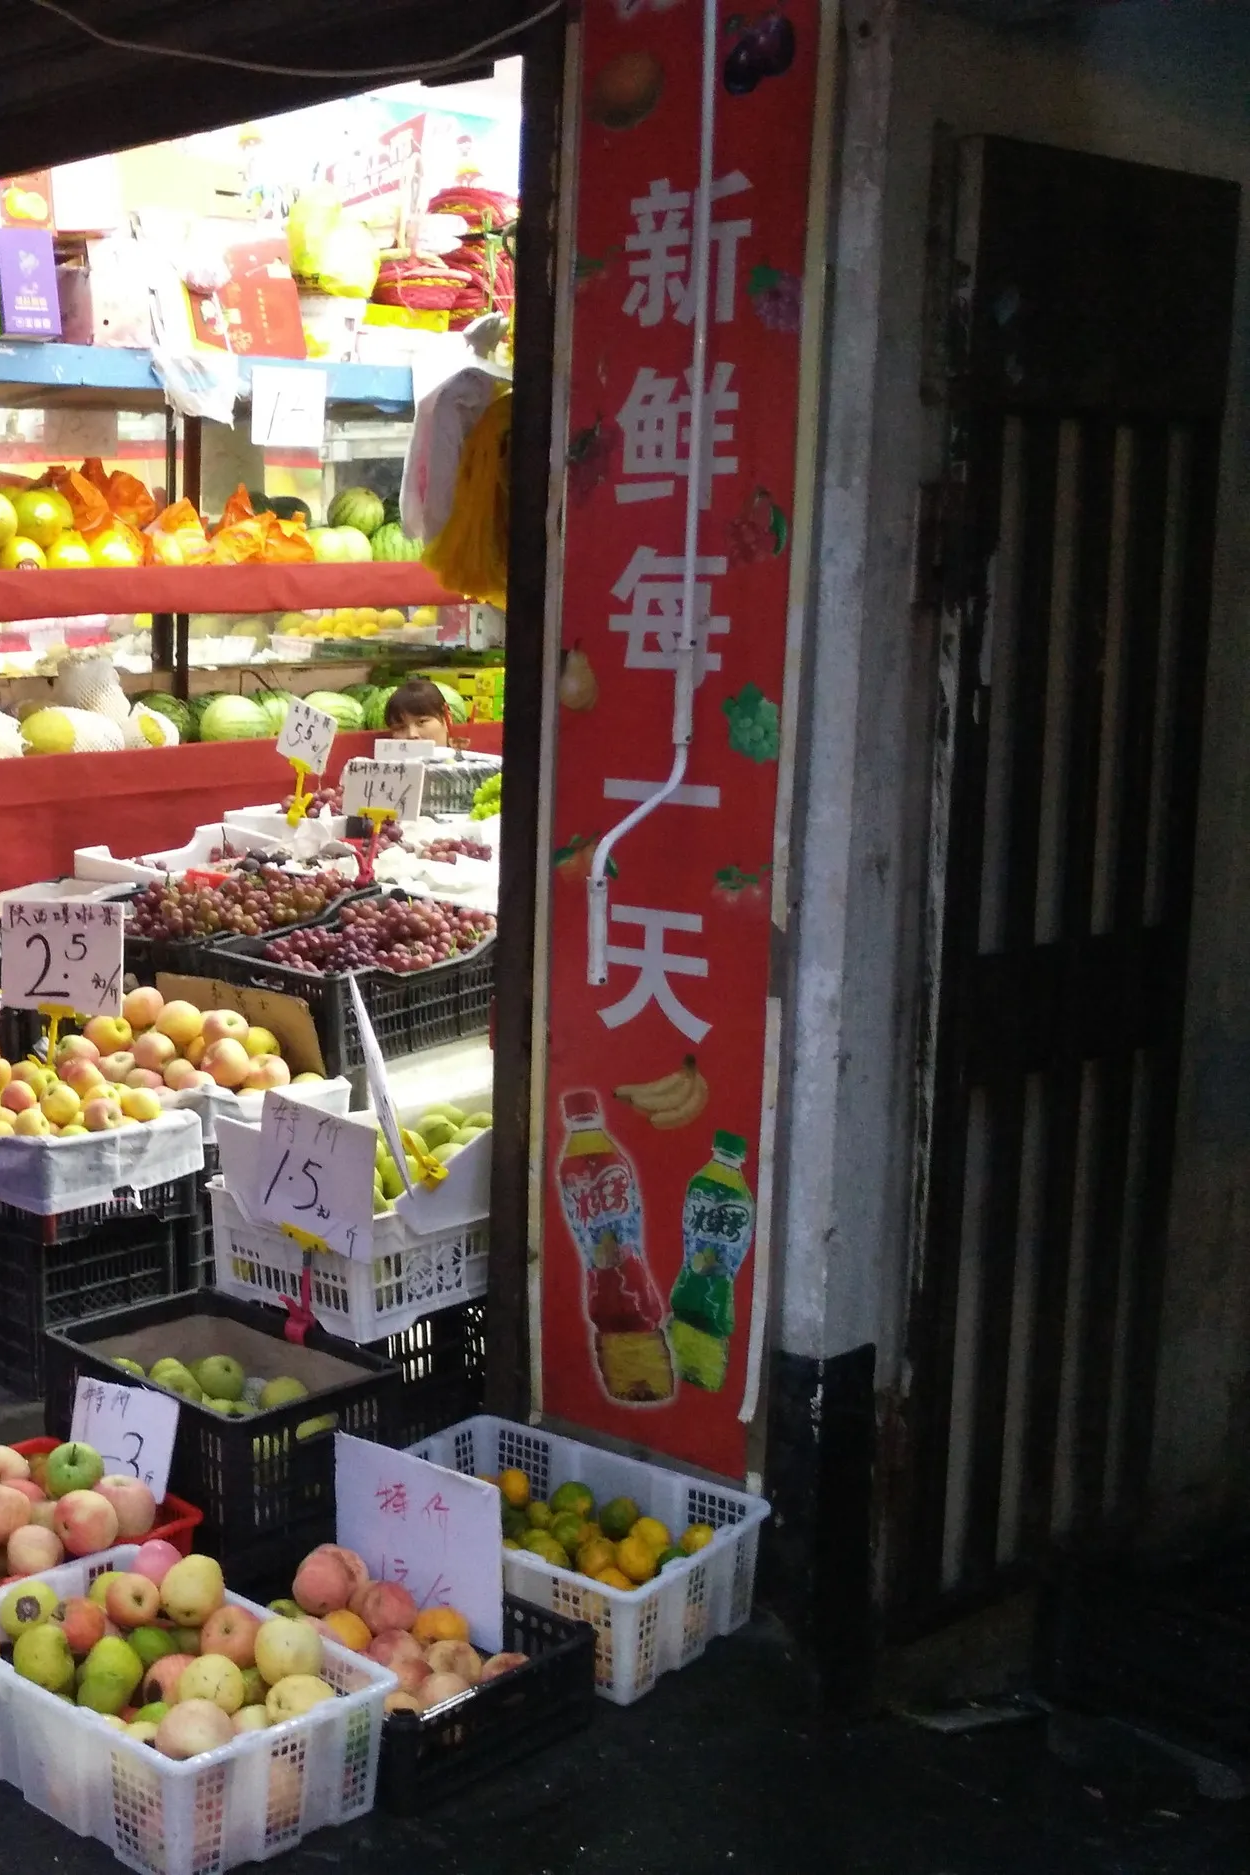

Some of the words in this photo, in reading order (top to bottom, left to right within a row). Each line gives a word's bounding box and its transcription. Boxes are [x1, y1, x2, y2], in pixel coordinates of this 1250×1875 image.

[597, 170, 753, 1044] 新鲜每一天
[271, 1101, 344, 1155] 特价
[81, 1384, 132, 1420] 特价
